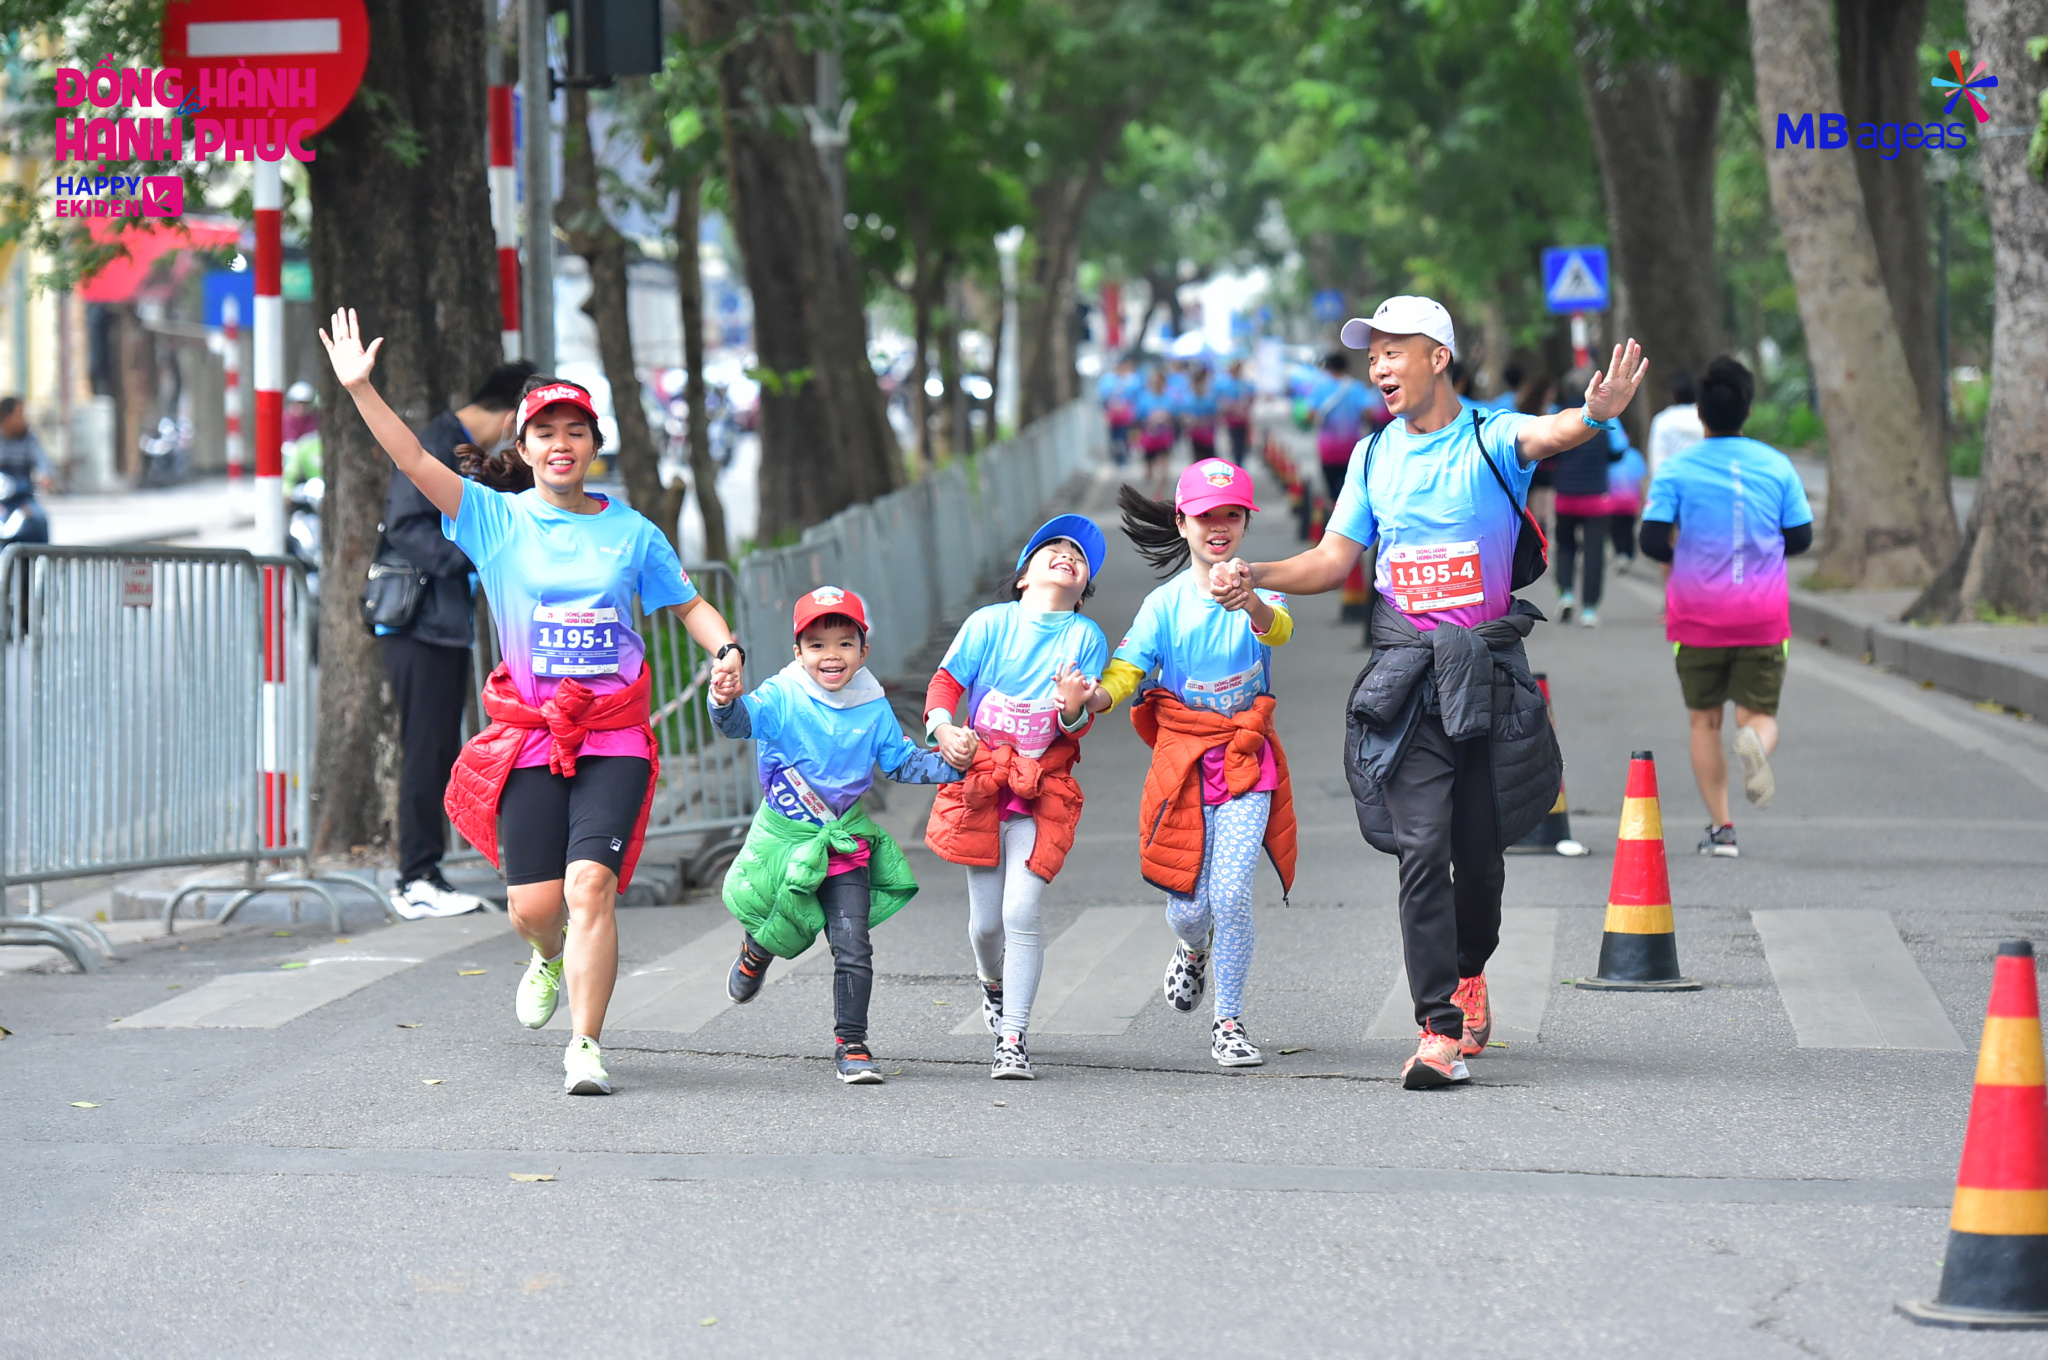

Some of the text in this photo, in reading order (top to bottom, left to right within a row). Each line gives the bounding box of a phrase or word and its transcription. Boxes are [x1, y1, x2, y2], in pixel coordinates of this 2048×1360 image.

[1396, 561, 1475, 586] 1195-4
[538, 627, 614, 649] 1195-1
[1192, 680, 1262, 711] 1195-3
[980, 707, 1051, 736] 1195-2
